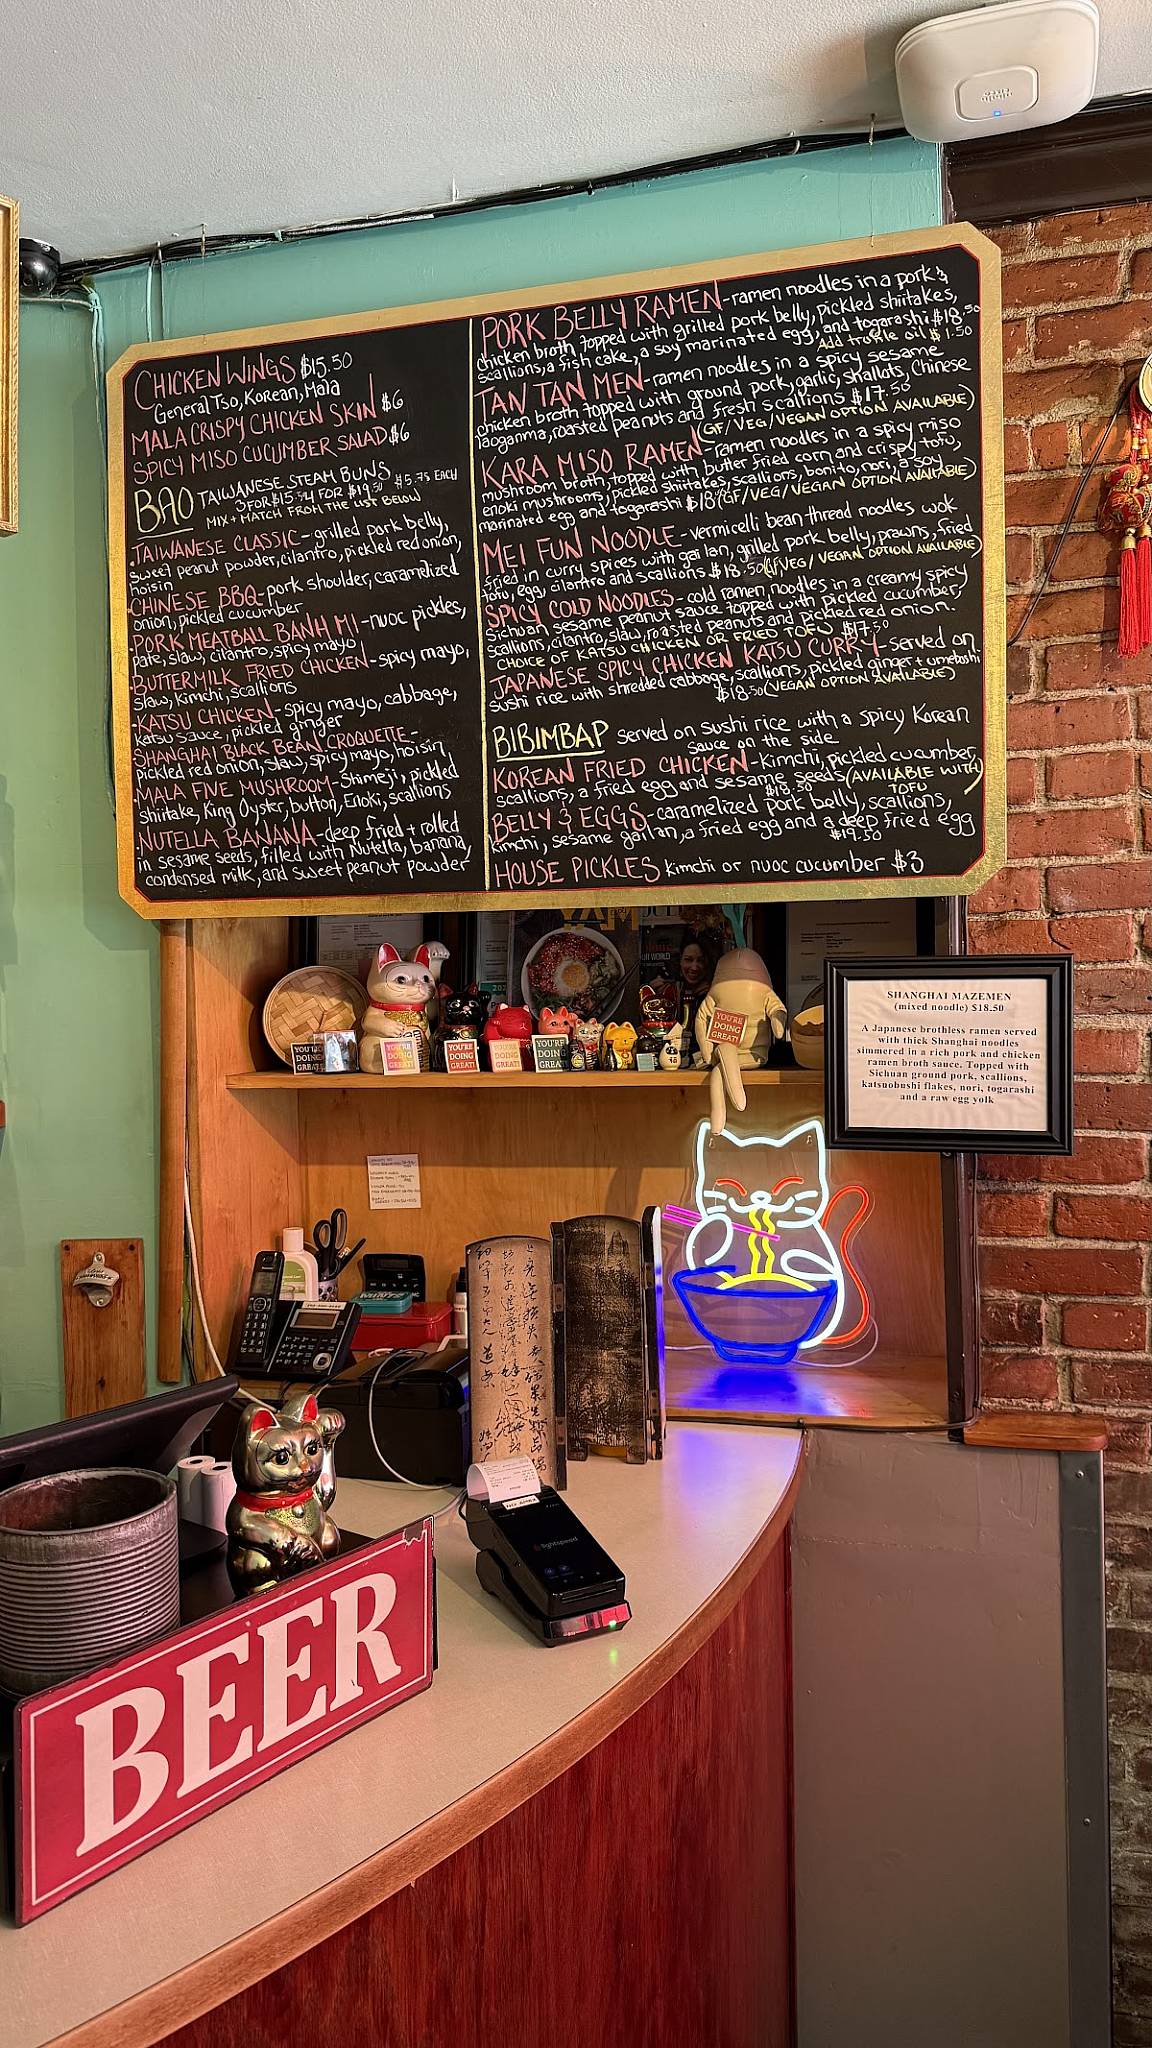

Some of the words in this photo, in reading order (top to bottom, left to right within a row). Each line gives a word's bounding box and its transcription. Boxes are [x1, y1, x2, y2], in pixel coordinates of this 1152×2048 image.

[481, 310, 546, 358] PORK
[554, 298, 628, 341] BELLY
[135, 355, 221, 410] CHICKEN
[227, 352, 296, 384] WINGS
[301, 352, 352, 379] $15.50
[474, 382, 527, 423] TAN
[533, 370, 586, 407] TAN
[851, 383, 912, 406] $17.50
[131, 430, 187, 457] MALA
[191, 416, 245, 445] CRISPY
[250, 402, 323, 434] CHICKEN
[331, 373, 376, 427] SKIN
[381, 390, 404, 412] $6
[831, 402, 889, 420] OPTION
[133, 458, 183, 486] SPICY
[192, 449, 238, 475] MISO
[243, 438, 337, 465] CUCUMBER
[480, 453, 550, 490] KARA
[557, 448, 614, 480] MISO
[197, 478, 284, 511] TAIWANESE
[287, 469, 336, 490] STEAM
[341, 460, 391, 483] BUNS
[434, 468, 457, 482] EACH
[135, 487, 194, 533] BAO
[367, 517, 403, 542] pork
[404, 510, 449, 537] belly,
[482, 537, 526, 576] MEI
[536, 526, 583, 564] FUN
[189, 628, 272, 652] MEATBALL
[275, 613, 329, 642] BANH
[411, 595, 466, 632] pickles,
[486, 602, 541, 629] SPICY
[549, 599, 592, 621] COLD
[497, 657, 546, 671] CHOICE
[551, 651, 570, 665] OF
[576, 643, 627, 662] KATSU
[631, 634, 701, 653] CHICKEN
[706, 632, 728, 645] OR
[733, 628, 779, 643] FRIED
[783, 621, 834, 638] TOFU
[246, 663, 294, 685] FRIED
[421, 643, 469, 668] mayo,
[489, 666, 591, 700] JAPANESE
[598, 658, 645, 682] SPICY
[651, 643, 734, 676] CHICKEN
[743, 638, 802, 666] KATSU
[492, 719, 609, 760] BIBIMBAP
[674, 726, 697, 740] on
[701, 713, 748, 735] sushi
[754, 715, 791, 733] rice
[797, 709, 838, 730] with
[841, 713, 852, 726] a
[912, 703, 970, 724] Korean
[737, 738, 756, 750] on
[761, 733, 792, 747] the
[800, 730, 840, 746] side
[222, 741, 269, 761] BLACK
[272, 731, 322, 754] BEAN
[493, 758, 575, 793] KOREAN
[583, 757, 646, 783] FRIED
[193, 778, 234, 799] FIVE
[766, 782, 812, 798] $18.50
[888, 782, 928, 794] TOFU
[366, 814, 405, 840] fried
[420, 811, 459, 835] rolled
[491, 807, 551, 844] BELLY
[829, 827, 883, 842] $19.50
[138, 854, 151, 872] in
[158, 852, 211, 869] sesame
[215, 849, 258, 870] seeds,
[261, 843, 301, 866] filled
[308, 843, 345, 861] with
[349, 838, 407, 858] Nutella,
[411, 835, 472, 861] banana,
[494, 859, 565, 890] HOUSE
[571, 854, 661, 883] PICKLES
[664, 856, 717, 878] kimchi
[722, 861, 742, 873] or
[750, 859, 791, 874] nuoc
[795, 849, 886, 874] cucumber
[891, 848, 924, 874] $3
[887, 990, 949, 1001] SHANGHAI
[951, 991, 1012, 1001] MAZEMEN
[894, 1001, 928, 1012] (mixed
[931, 1002, 969, 1013] noodle)
[971, 1003, 1005, 1013] $18.50
[713, 1022, 741, 1033] DOING
[716, 1012, 743, 1024] YOU'RE
[711, 1031, 739, 1042] GREAT!
[861, 1024, 870, 1033] A
[872, 1024, 917, 1034] Japanese
[920, 1025, 966, 1035] brothless
[969, 1027, 1001, 1036] ramen
[1004, 1027, 1038, 1037] served
[878, 1036, 900, 1045] with
[903, 1036, 928, 1046] thick
[931, 1036, 978, 1048] Shanghai
[981, 1038, 1019, 1048] noodles
[536, 1039, 564, 1048] YOU'RE
[857, 1047, 904, 1056] simmered
[907, 1047, 917, 1056] in
[920, 1049, 927, 1057] a
[929, 1048, 950, 1057] rich
[953, 1049, 977, 1060] pork
[980, 1049, 999, 1058] and
[1002, 1050, 1041, 1060] chicken
[449, 1052, 474, 1060] DOING
[451, 1061, 475, 1069] GREAT!
[867, 1059, 899, 1068] ramen
[901, 1059, 929, 1068] broth
[932, 1061, 962, 1070] sauce.
[966, 1060, 1003, 1073] Topped
[1007, 1062, 1029, 1071] with
[861, 1080, 921, 1091] katsuobushi
[924, 1081, 956, 1092] flakes,
[960, 1084, 984, 1094] nori,
[987, 1084, 1035, 1096] togarashi
[869, 1069, 908, 1079] Sichuan
[911, 1070, 947, 1081] ground
[950, 1071, 977, 1083] pork,
[980, 1073, 1027, 1084] scallions,
[900, 1093, 918, 1102] and
[921, 1094, 927, 1102] a
[930, 1094, 949, 1102] raw
[952, 1095, 970, 1105] egg
[972, 1094, 994, 1105] yolk
[540, 1536, 578, 1549] lightspeed
[75, 1572, 402, 1857] BEER
